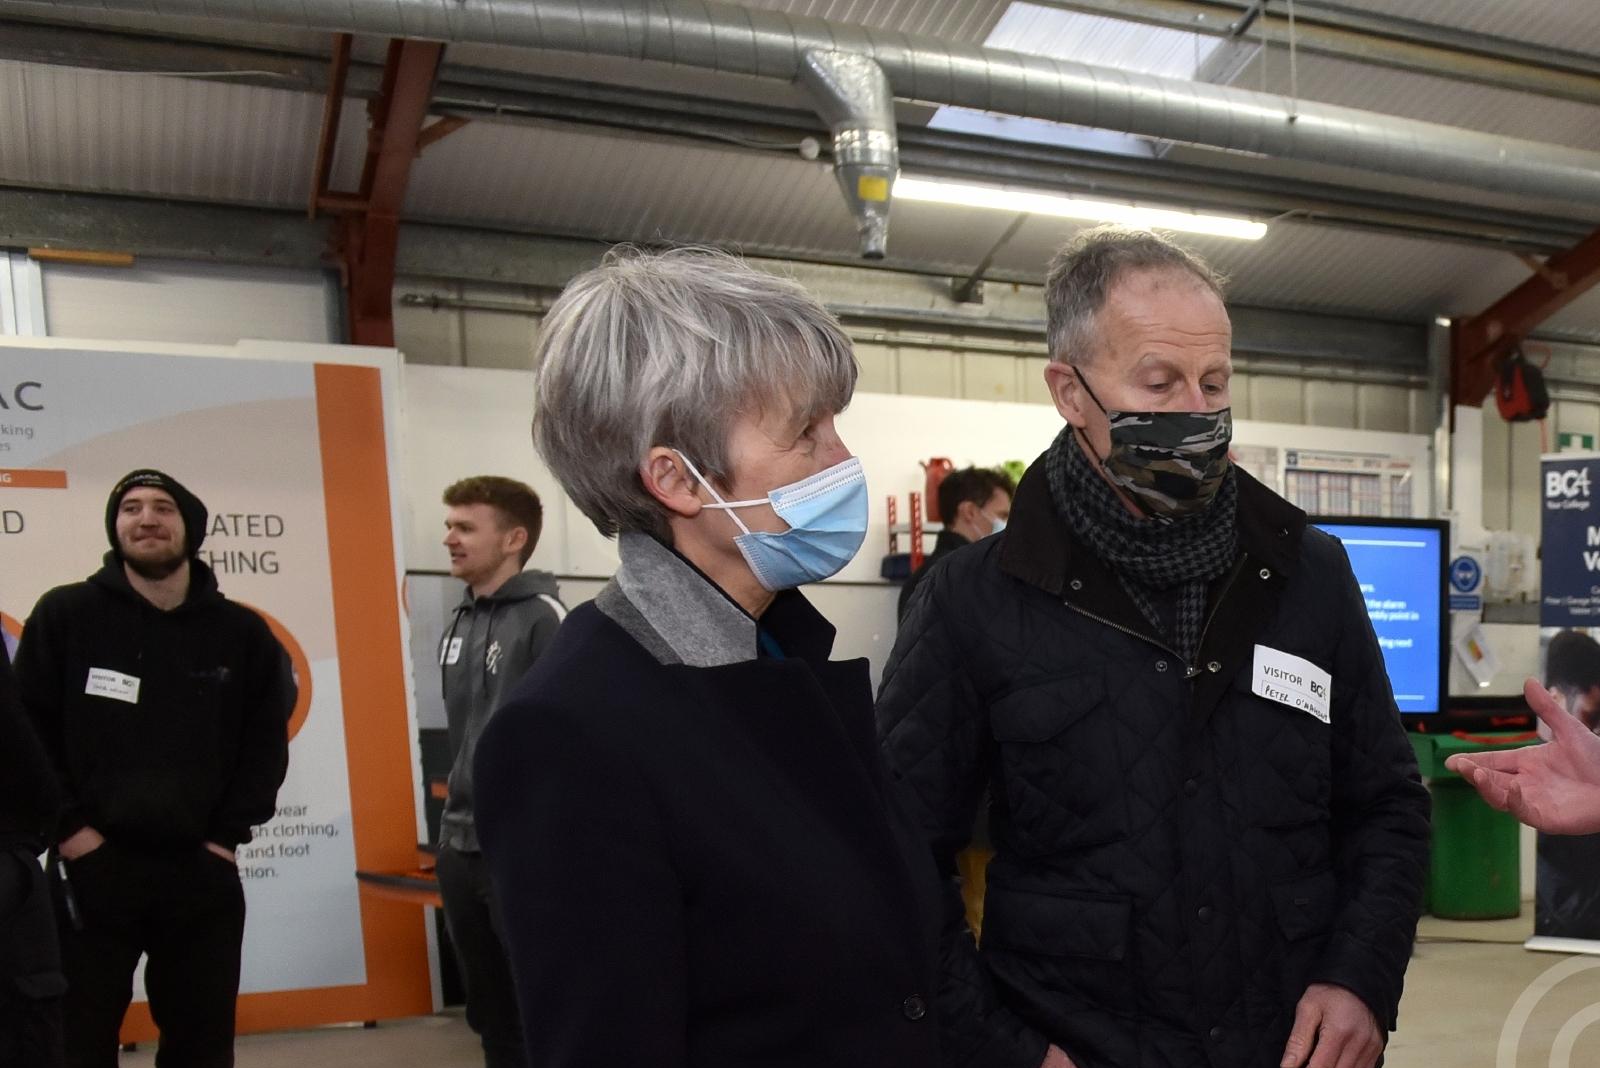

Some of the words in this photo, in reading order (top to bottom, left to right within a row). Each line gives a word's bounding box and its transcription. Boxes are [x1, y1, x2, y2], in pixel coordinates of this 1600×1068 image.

[0, 510, 25, 534] D
[206, 513, 284, 538] ATED
[1263, 665, 1303, 686] VISITOR
[272, 823, 339, 839] clothing,
[245, 845, 275, 859] and
[241, 866, 279, 880] tion.
